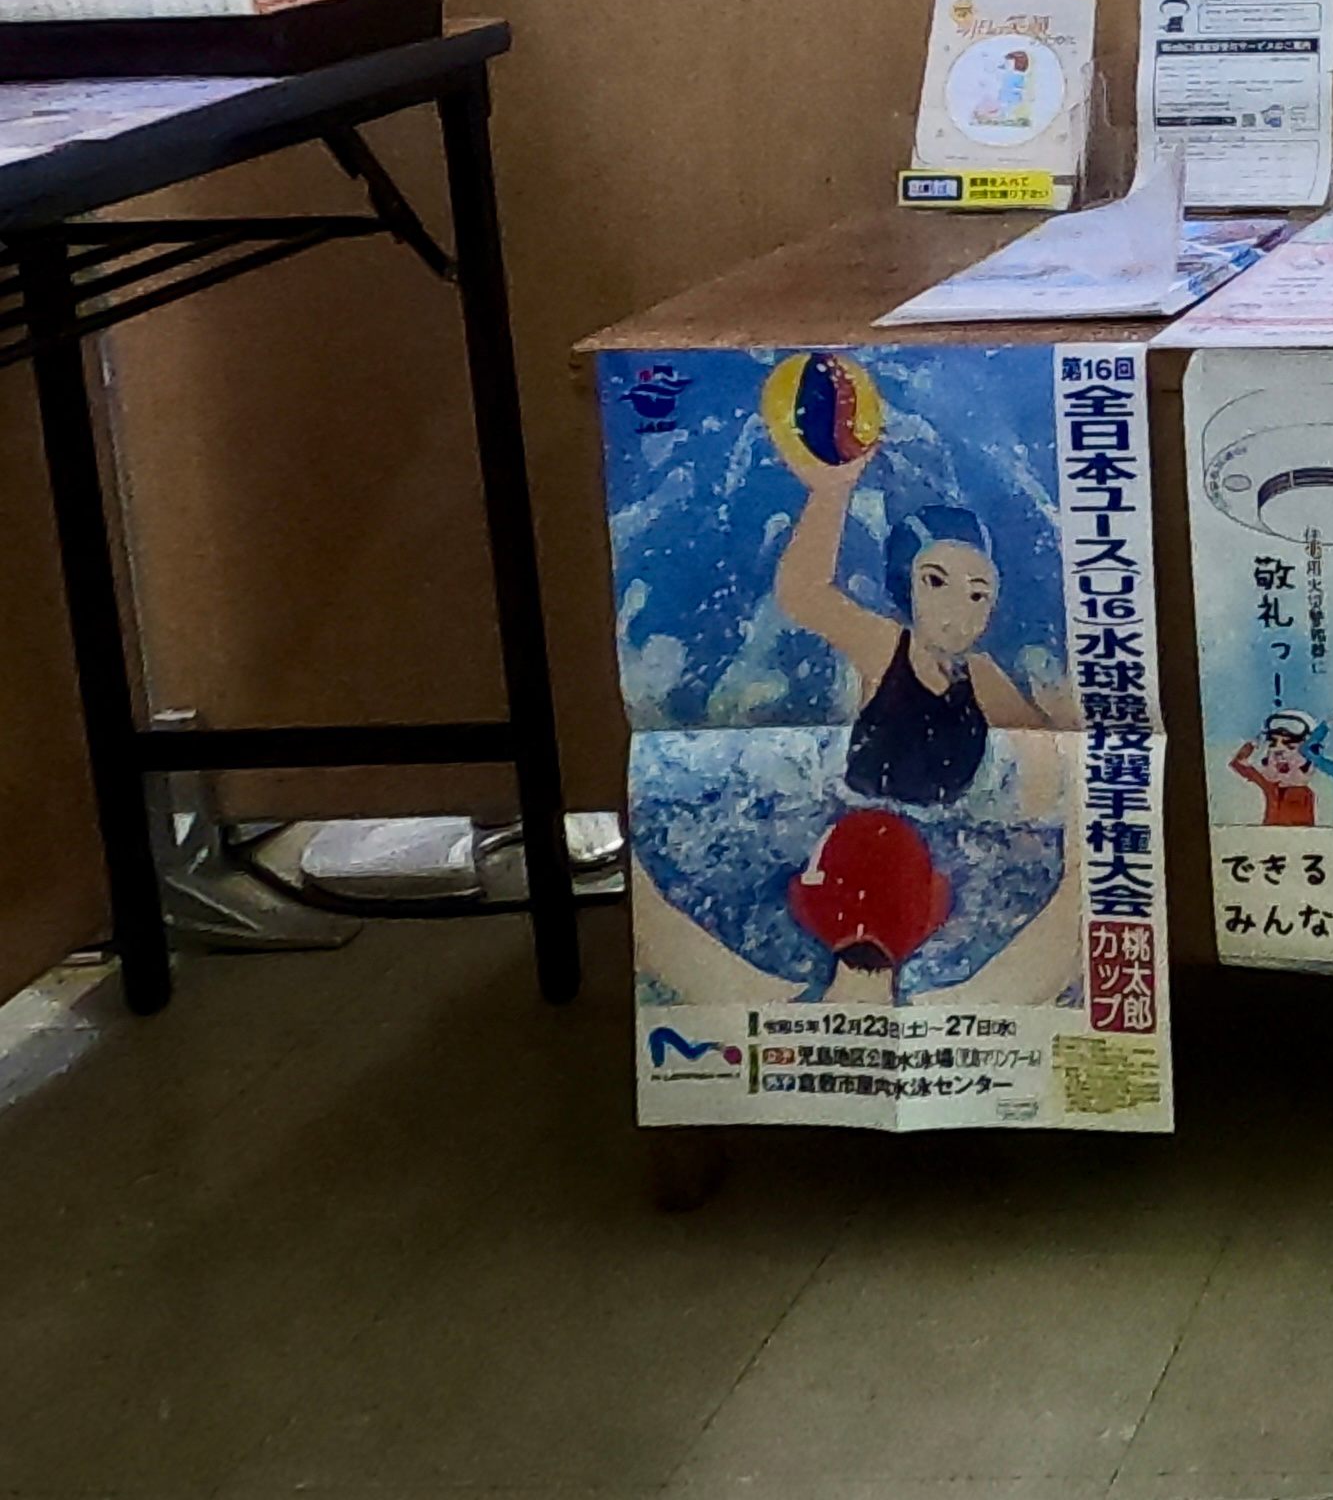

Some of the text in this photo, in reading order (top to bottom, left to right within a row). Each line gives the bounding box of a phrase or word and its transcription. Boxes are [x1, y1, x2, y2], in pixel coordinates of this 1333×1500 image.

[1061, 356, 1136, 382] 第16回
[1253, 556, 1296, 708] 敬礼っ!
[1092, 926, 1122, 1029] カップ
[1122, 926, 1155, 1029] 桃太郎
